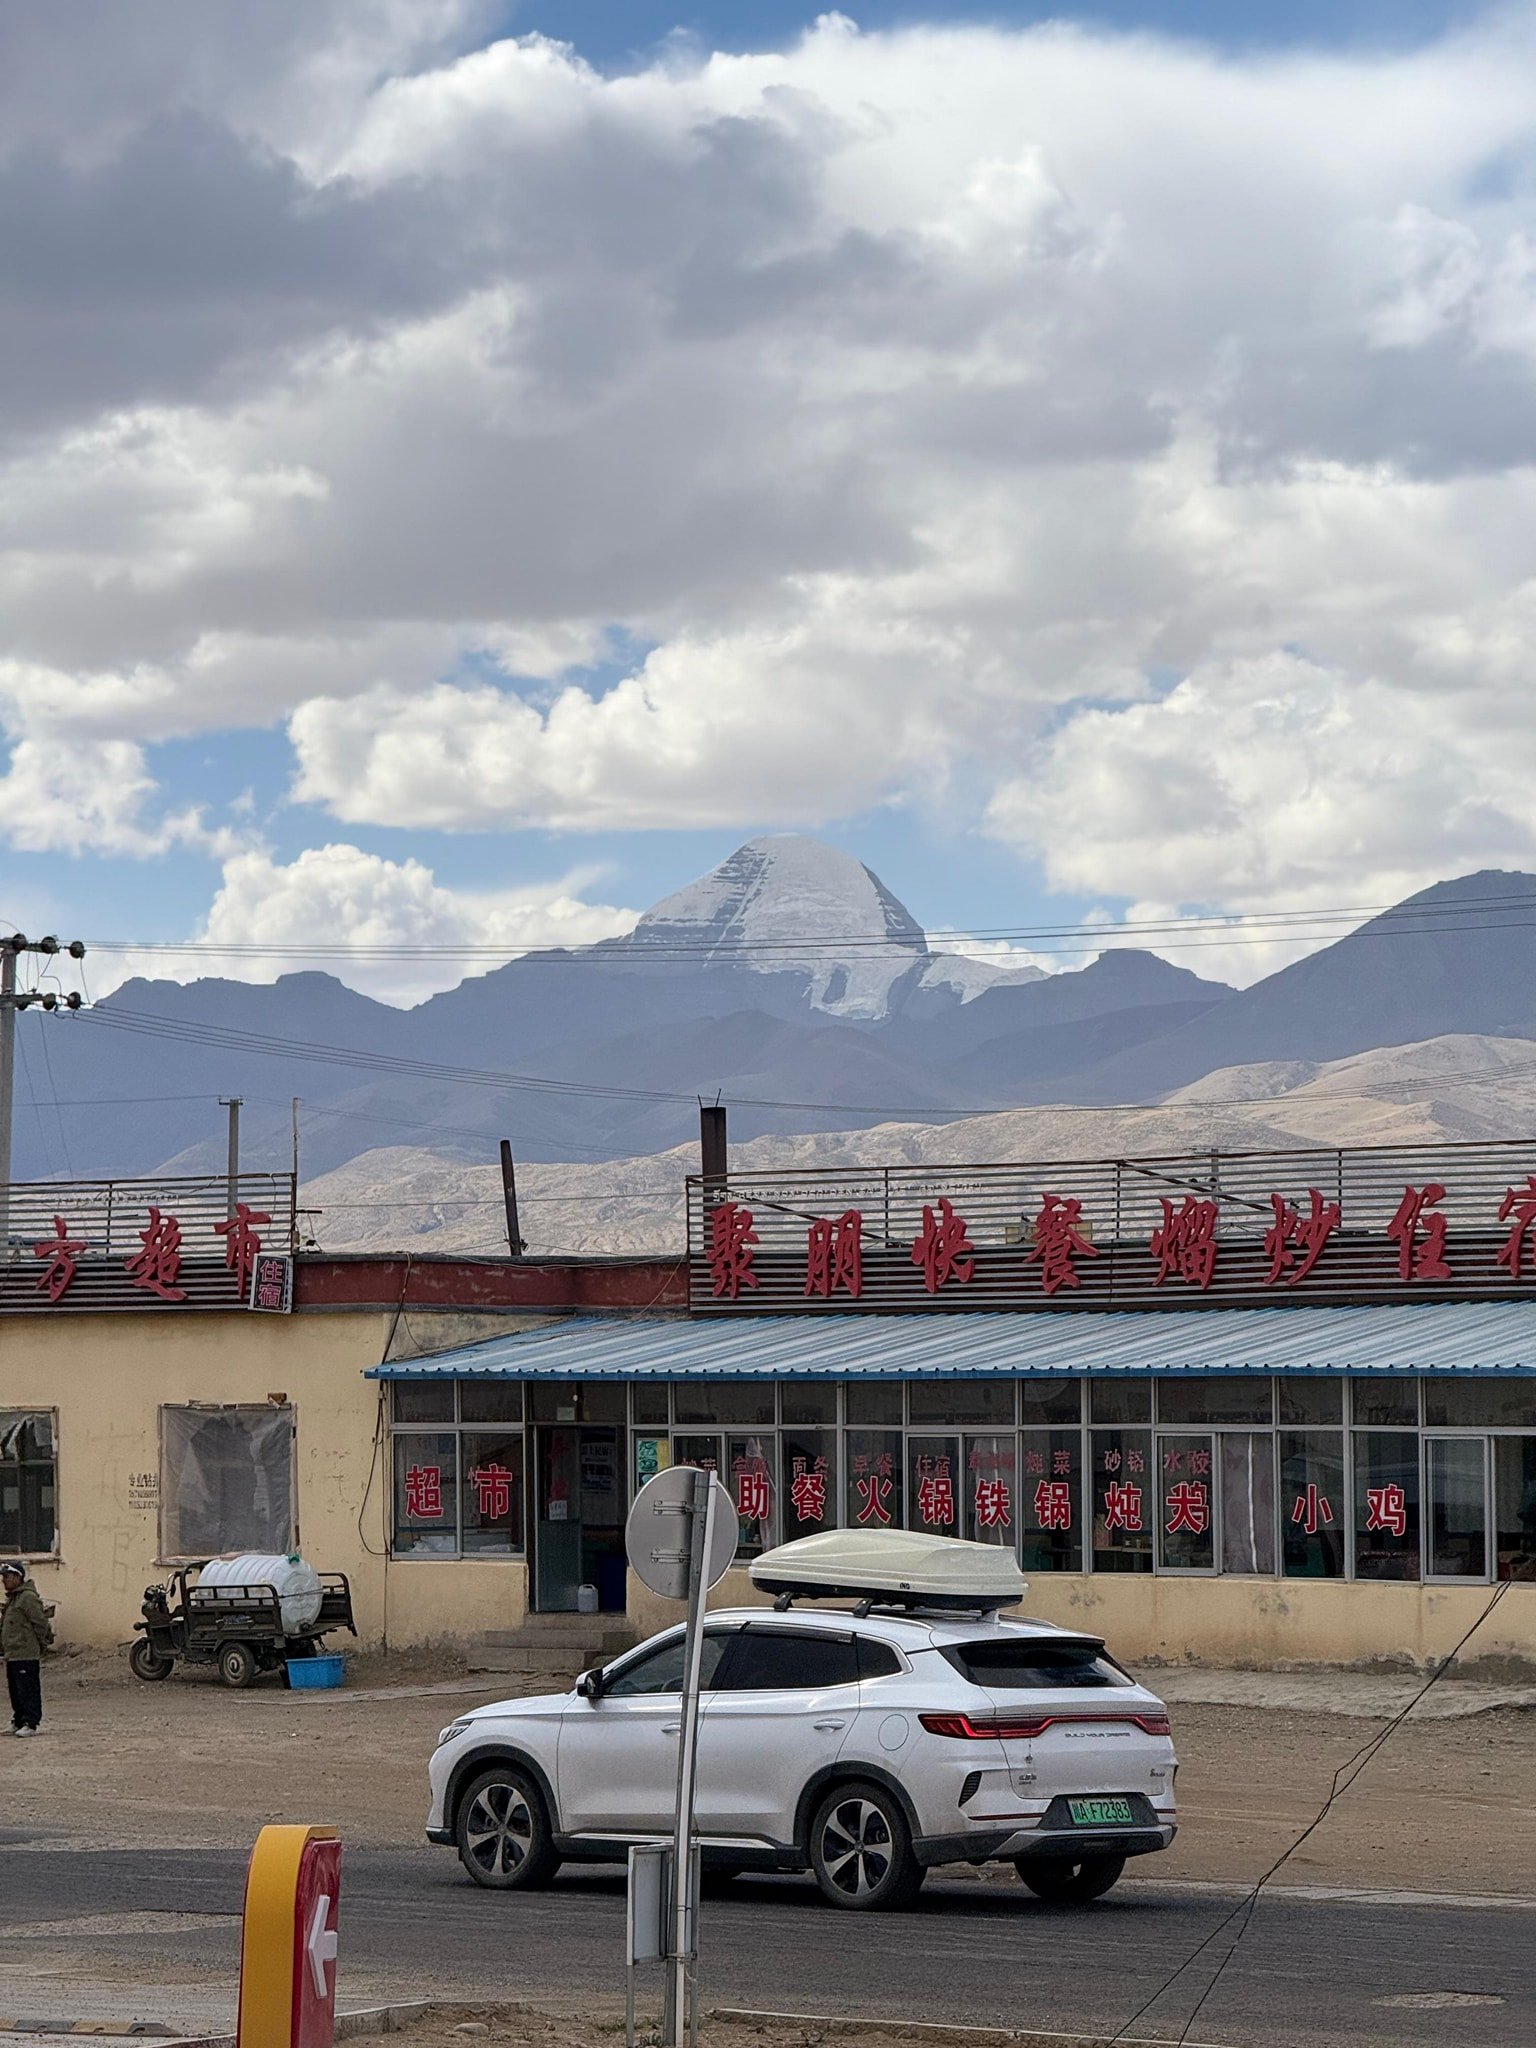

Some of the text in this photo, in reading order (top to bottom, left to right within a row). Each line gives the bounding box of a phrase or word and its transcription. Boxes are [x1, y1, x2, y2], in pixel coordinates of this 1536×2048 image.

[258, 1260, 283, 1307] 住宿
[853, 1452, 893, 1477] 早餐
[916, 1454, 951, 1477] 住宿
[1105, 1449, 1144, 1473] 砂锅
[1163, 1450, 1209, 1475] 水饺
[405, 1463, 513, 1519] 超市
[1291, 1483, 1406, 1536] 小鸡
